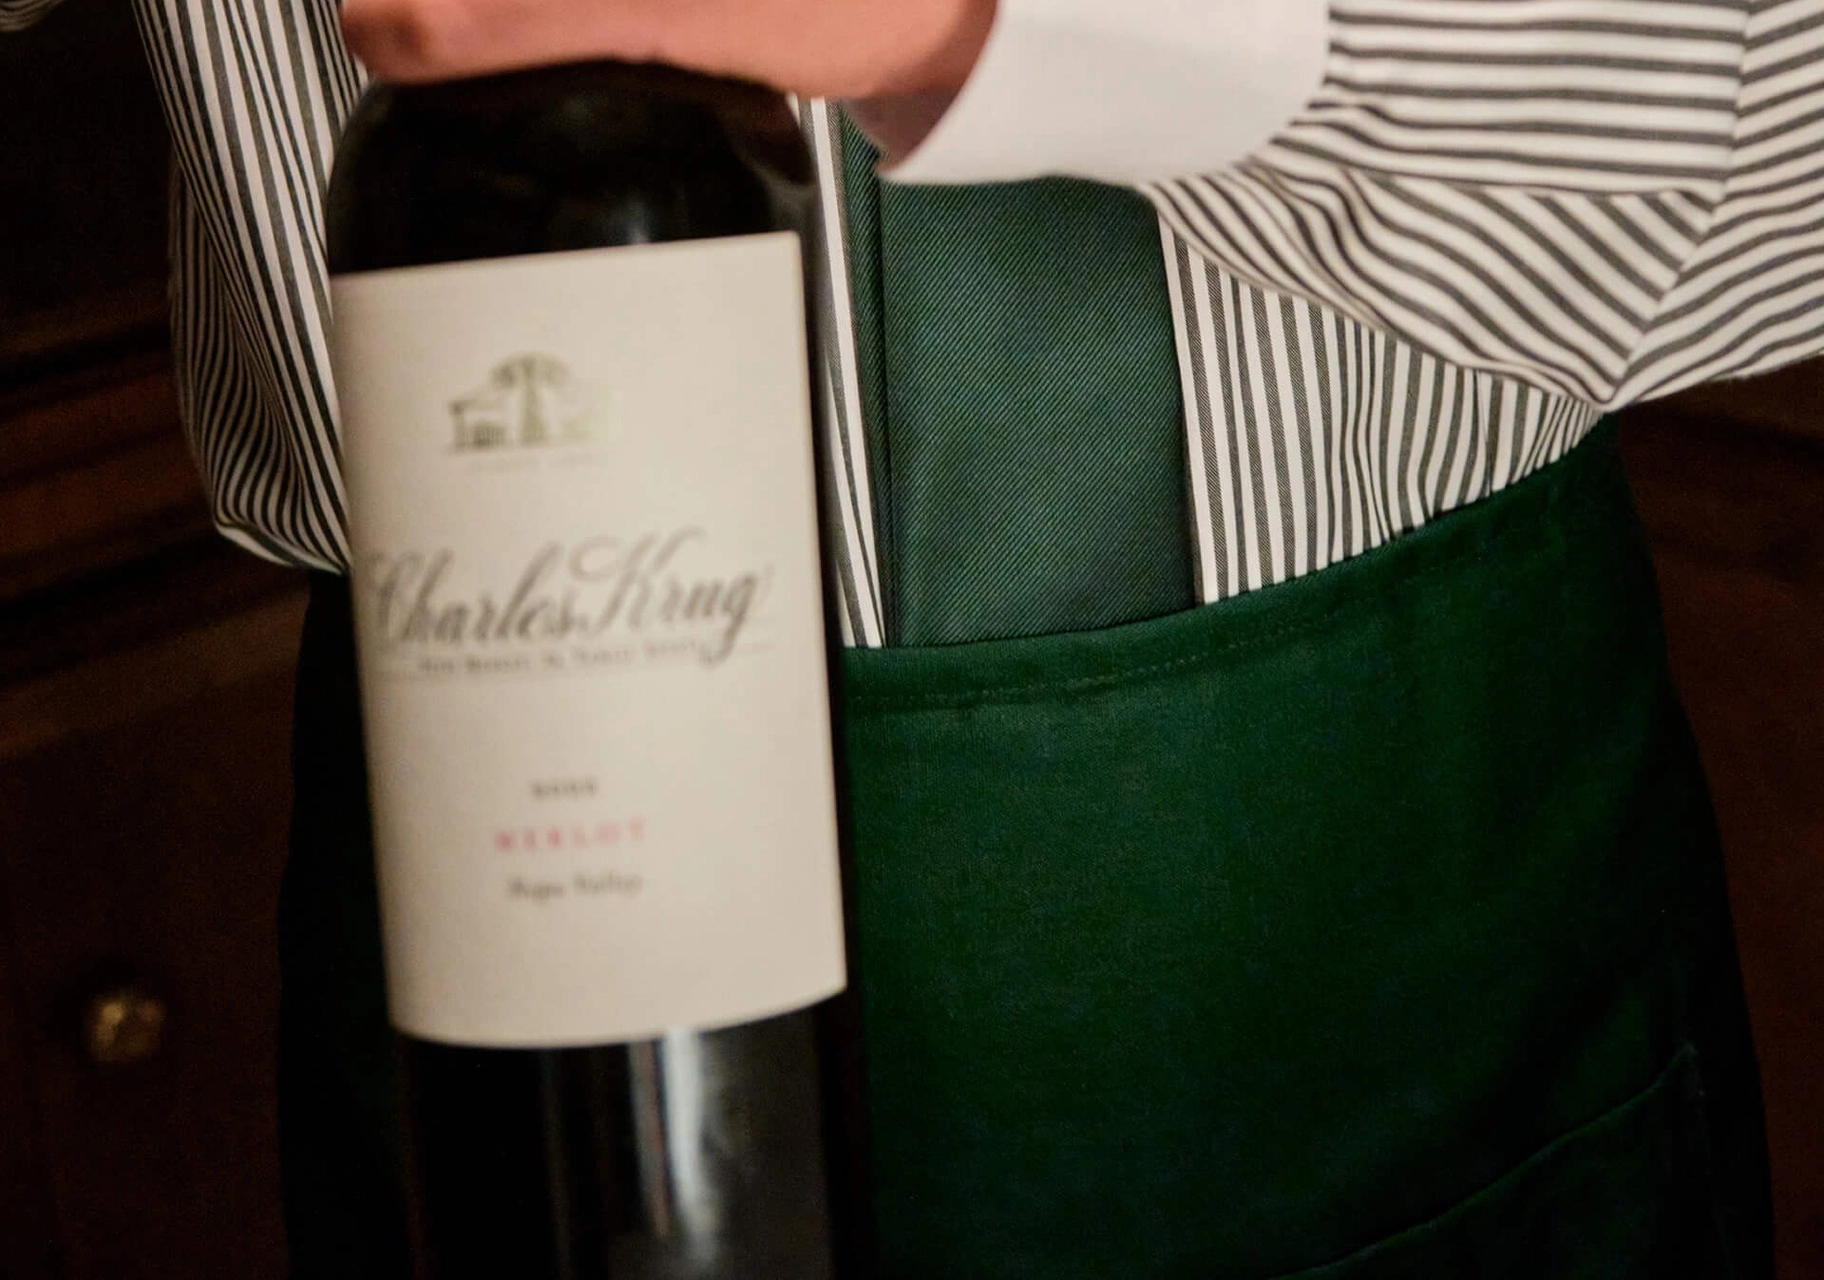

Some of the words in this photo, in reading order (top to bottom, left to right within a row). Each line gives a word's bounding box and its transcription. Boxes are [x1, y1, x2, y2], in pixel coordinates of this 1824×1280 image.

[368, 540, 586, 645] Charles
[568, 525, 774, 668] Krug
[494, 816, 646, 854] MERLOT
